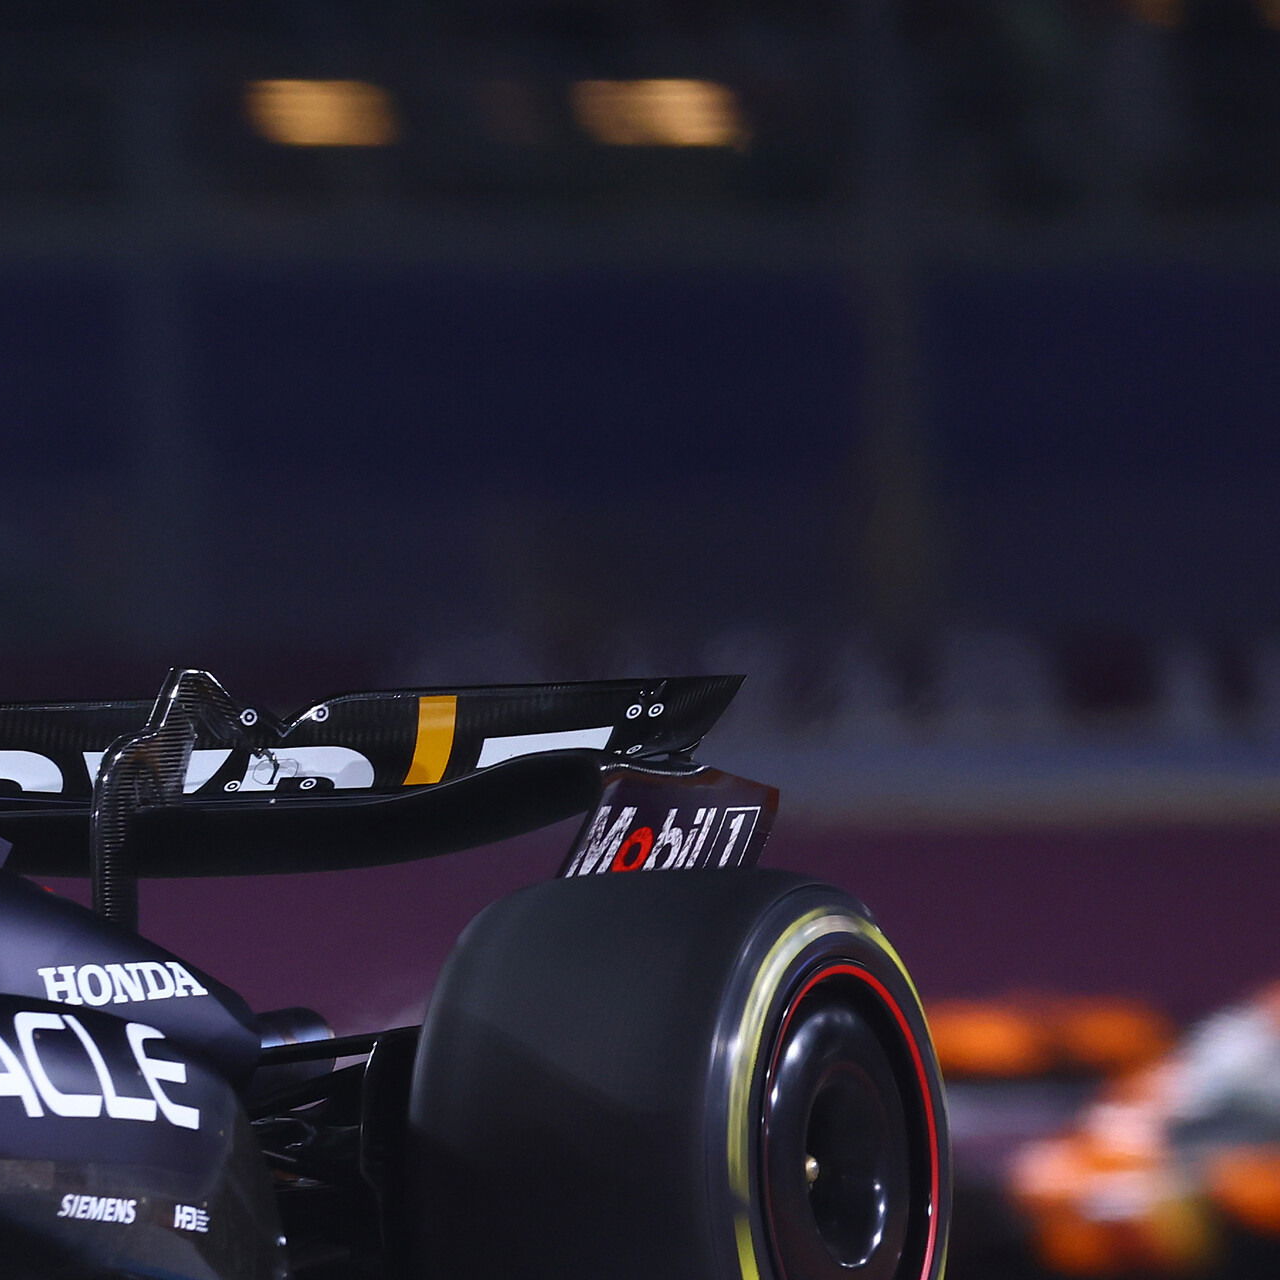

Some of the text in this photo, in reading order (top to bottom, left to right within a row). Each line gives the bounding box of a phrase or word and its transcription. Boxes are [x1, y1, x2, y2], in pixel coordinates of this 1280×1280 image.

[563, 805, 718, 878] Mobil
[37, 961, 209, 1007] HONDA
[57, 1193, 137, 1225] SIEMENS
